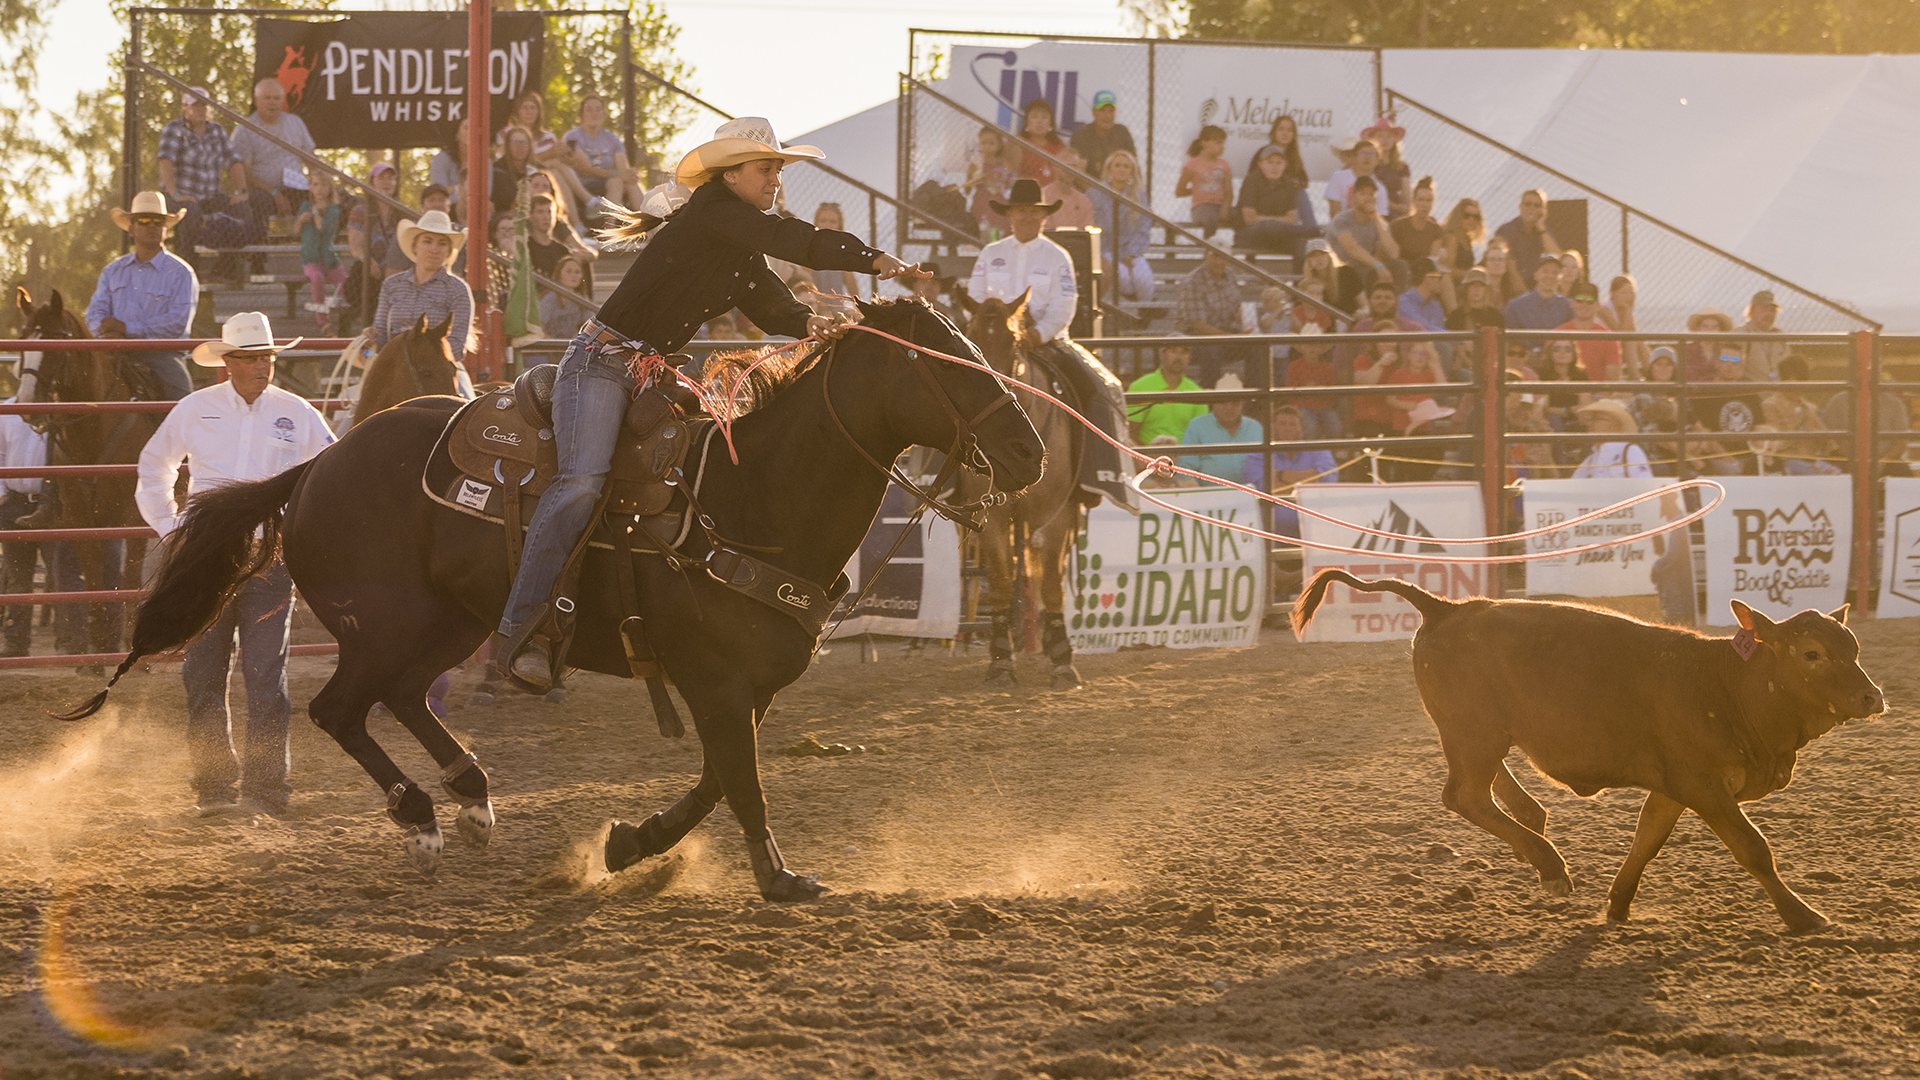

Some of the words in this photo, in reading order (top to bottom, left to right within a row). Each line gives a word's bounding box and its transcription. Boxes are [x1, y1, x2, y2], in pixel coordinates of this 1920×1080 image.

[320, 41, 529, 100] PENDLEON
[370, 101, 464, 121] WHISK
[482, 425, 522, 446] Coats
[1137, 508, 1240, 566] BANK
[1733, 508, 1834, 566] Riverside
[777, 583, 811, 609] Coats
[1130, 565, 1255, 627] IDAHO
[1312, 563, 1481, 605] TETON
[1351, 612, 1418, 633] TOYO
[1069, 631, 1148, 649] COMMITTED
[1153, 630, 1169, 645] TO
[1173, 626, 1249, 645] COMMUNITY
[1735, 634, 1753, 655] 14
